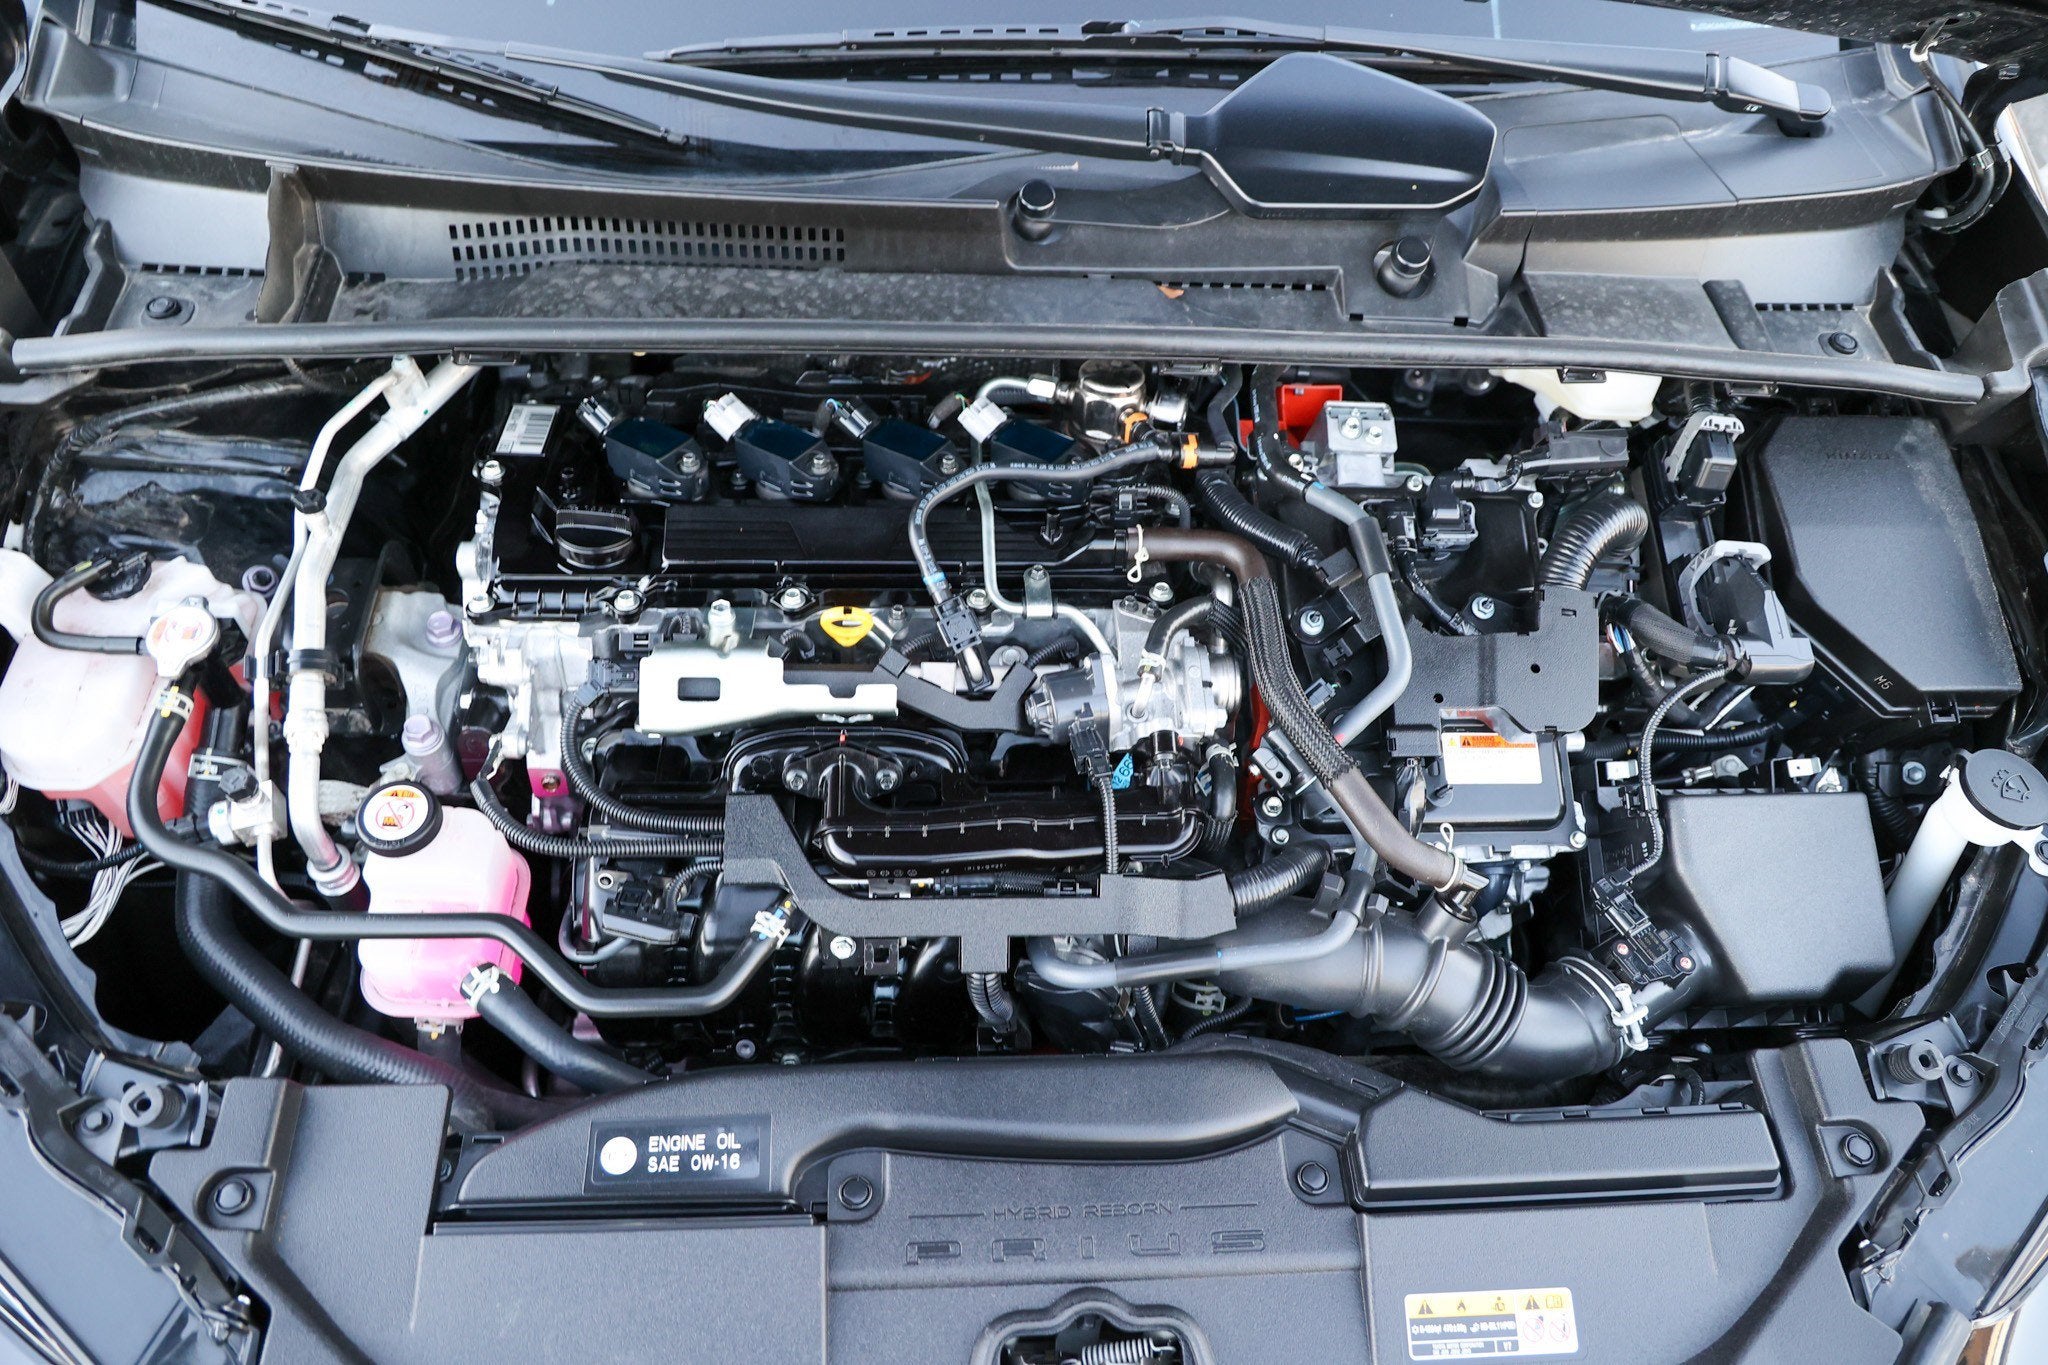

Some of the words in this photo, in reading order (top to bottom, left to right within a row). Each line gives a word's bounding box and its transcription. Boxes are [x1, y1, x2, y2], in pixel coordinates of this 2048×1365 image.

[648, 1133, 706, 1153] ENGINE
[716, 1132, 742, 1150] OIL
[647, 1154, 680, 1173] SAE
[690, 1152, 741, 1171] 0W-16
[993, 1205, 1072, 1221] HYBRID
[1083, 1201, 1172, 1219] REBORN
[905, 1229, 1266, 1266] PRIUS
